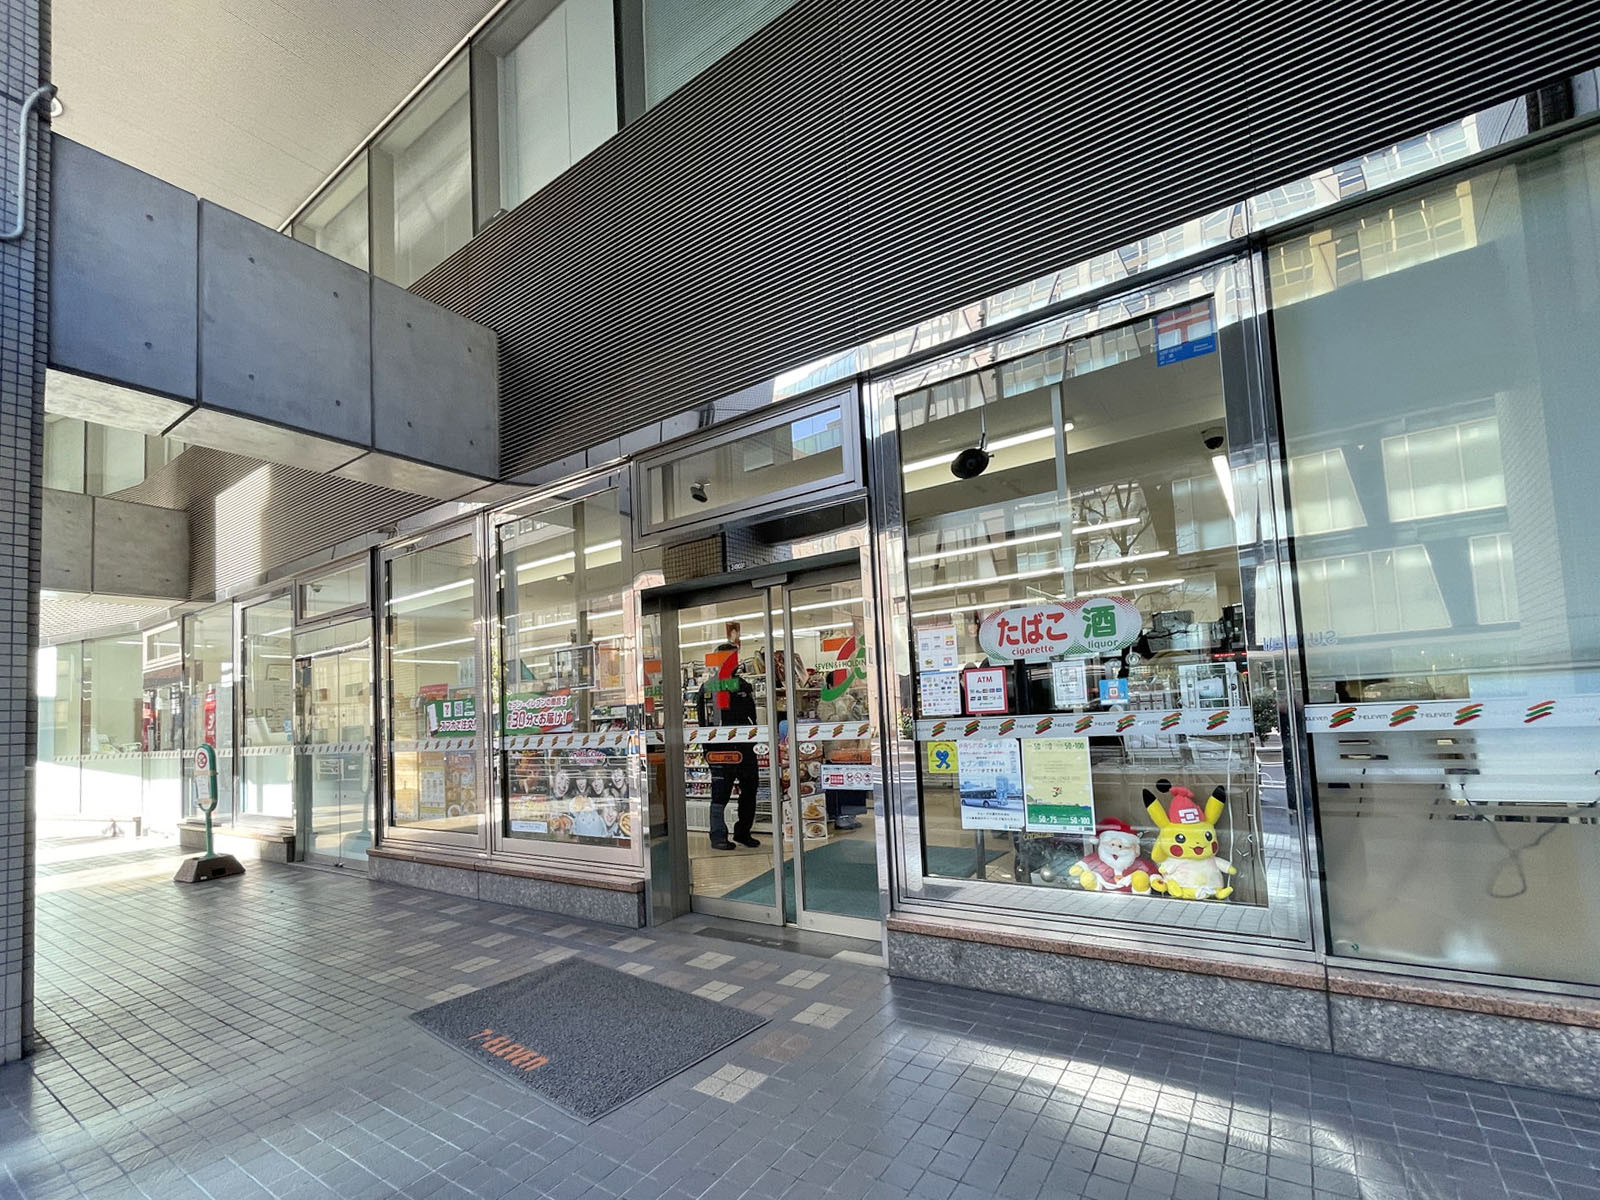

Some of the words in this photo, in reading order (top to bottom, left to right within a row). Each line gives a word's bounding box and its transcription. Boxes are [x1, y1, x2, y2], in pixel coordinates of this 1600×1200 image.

[1082, 605, 1117, 638] 酒
[997, 611, 1068, 647] たばこ
[1088, 638, 1119, 649] liquor
[1011, 645, 1055, 656] cigarette
[977, 675, 993, 684] ATM
